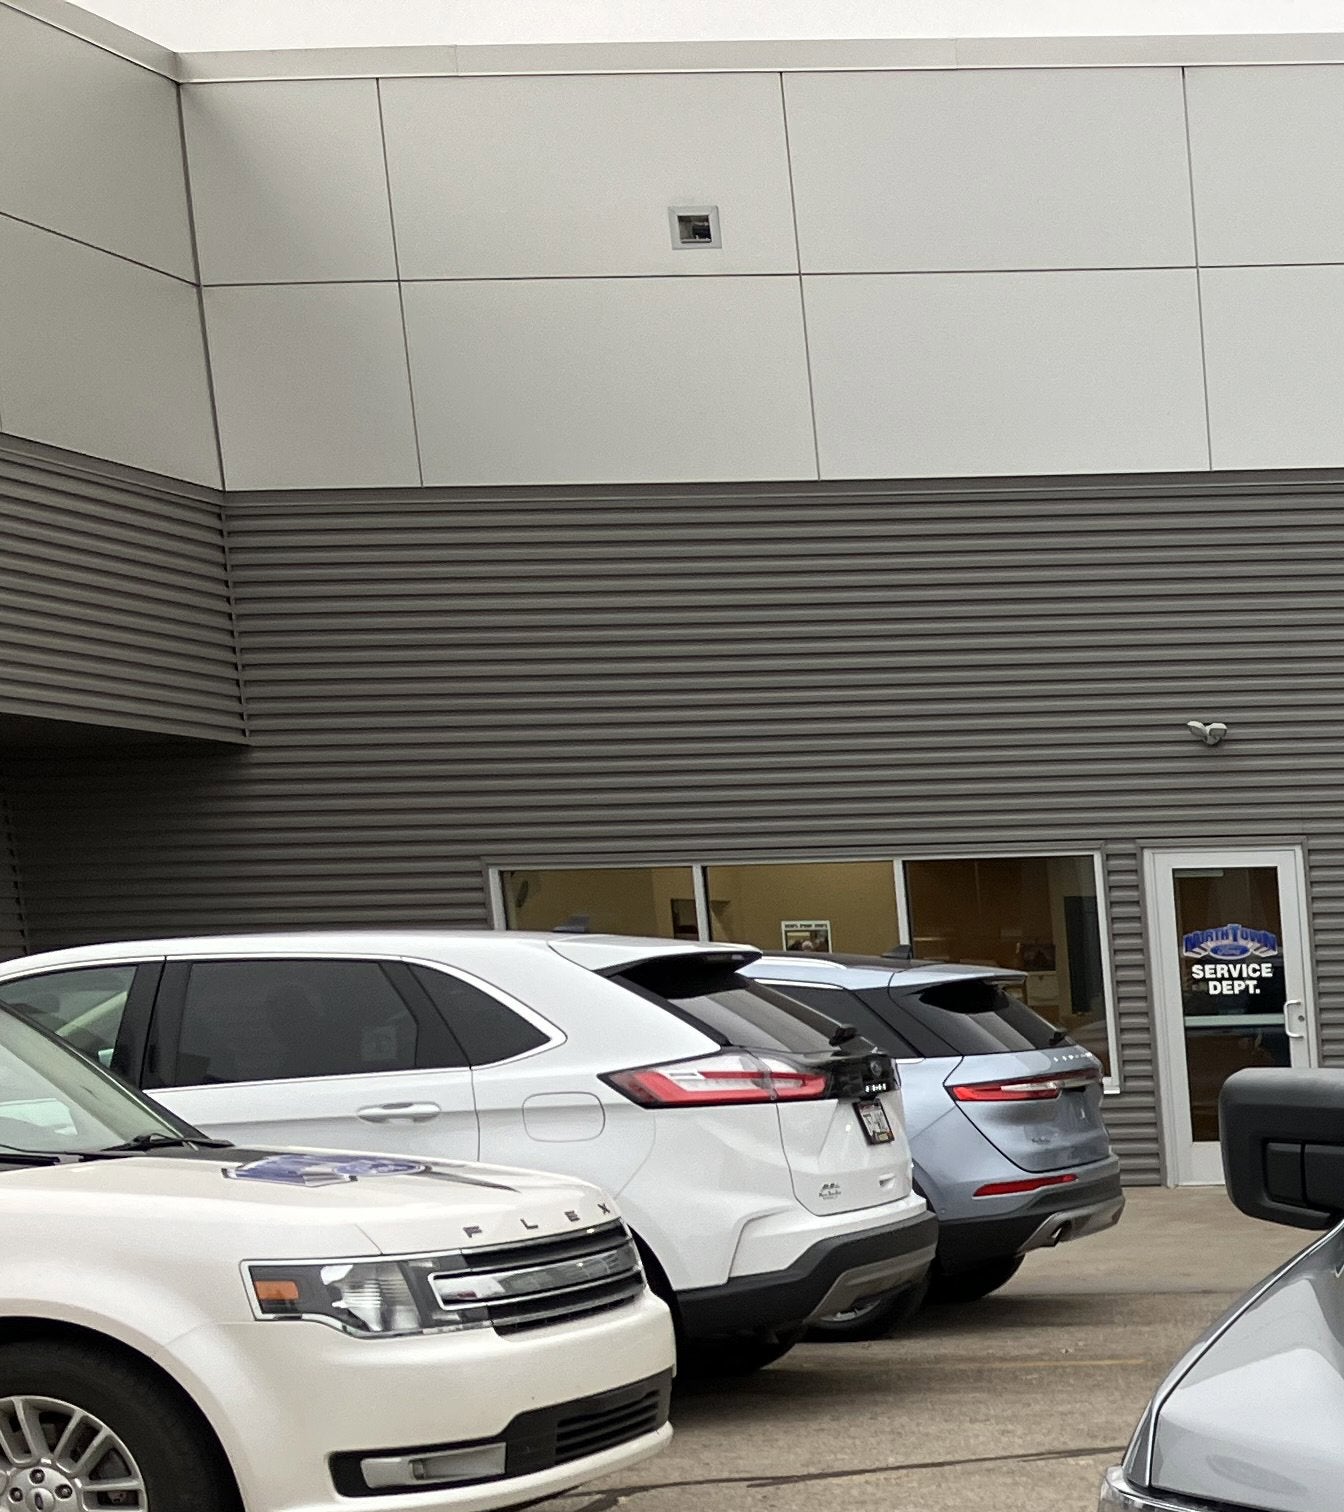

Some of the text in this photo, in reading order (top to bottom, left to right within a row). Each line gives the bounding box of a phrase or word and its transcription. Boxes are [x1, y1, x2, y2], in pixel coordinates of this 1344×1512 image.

[1191, 963, 1274, 979] SERVICE
[1208, 980, 1261, 995] DEPT.
[463, 1203, 611, 1238] FLEX
